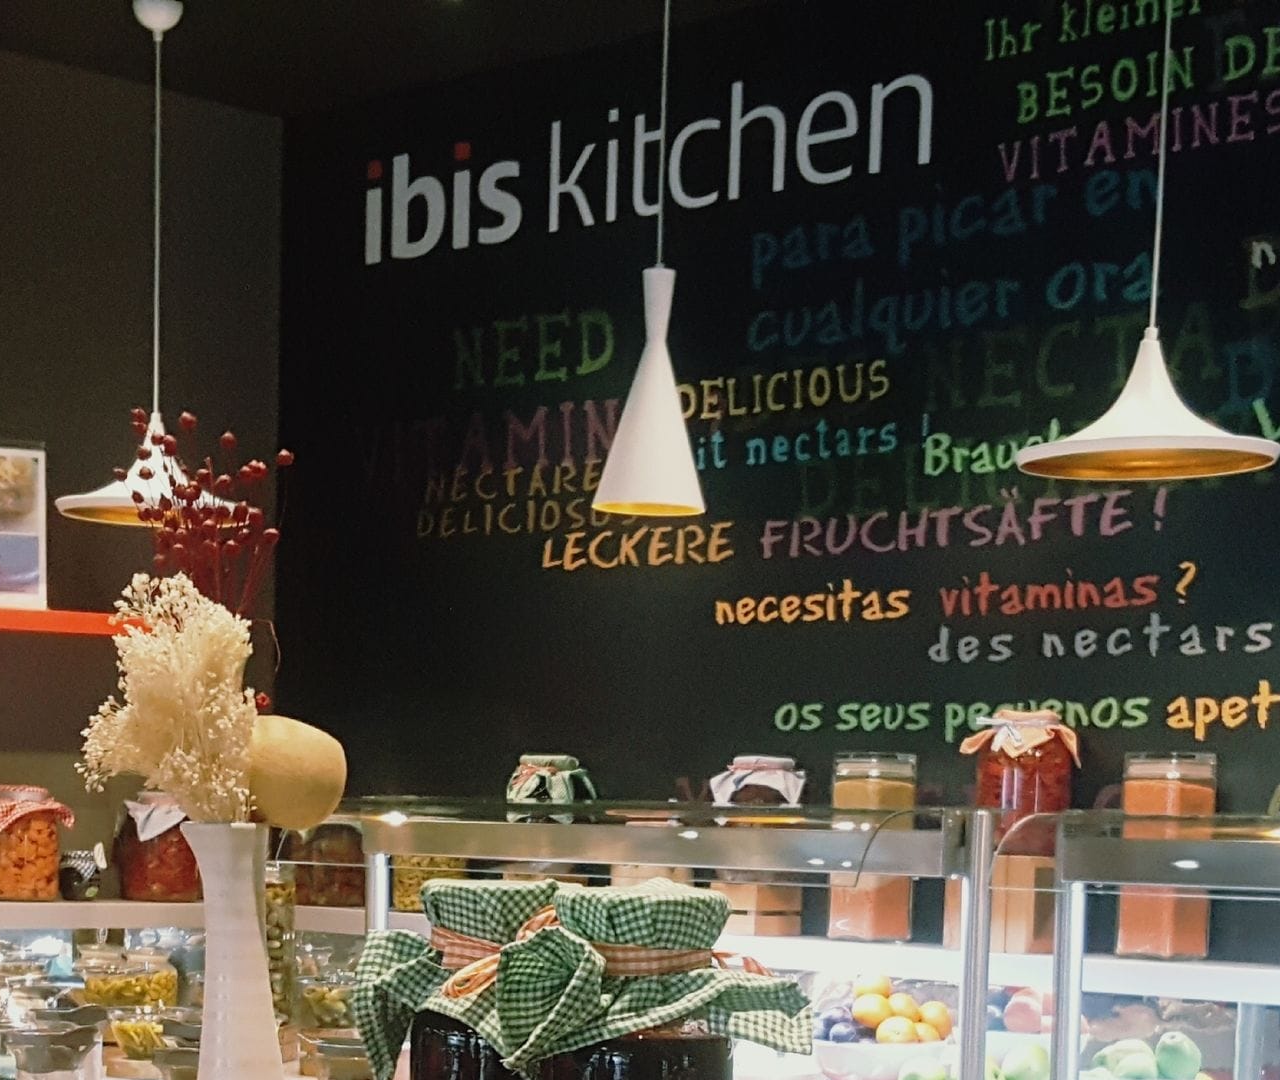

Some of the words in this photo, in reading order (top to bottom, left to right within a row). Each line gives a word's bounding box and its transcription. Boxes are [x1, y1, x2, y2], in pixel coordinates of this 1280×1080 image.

[983, 17, 1042, 61] Ihr
[1016, 46, 1196, 124] BESOIN
[364, 142, 521, 265] ibis
[547, 72, 934, 234] kitchen
[751, 217, 877, 290] para
[896, 182, 1058, 266] picar
[453, 309, 616, 390] NEED
[747, 272, 1019, 356] cualquier
[676, 358, 890, 420] DELICIOUS
[744, 421, 898, 466] nectars
[542, 521, 735, 571] LECKERE
[760, 485, 1135, 562] FRUCHTSÄFTE
[714, 578, 912, 625] necesitas
[938, 570, 1160, 618] vitaminas
[1175, 560, 1200, 605] ?
[927, 626, 1014, 664] des
[1040, 613, 1276, 660] nectars
[774, 700, 822, 732] os
[835, 700, 931, 732] seus
